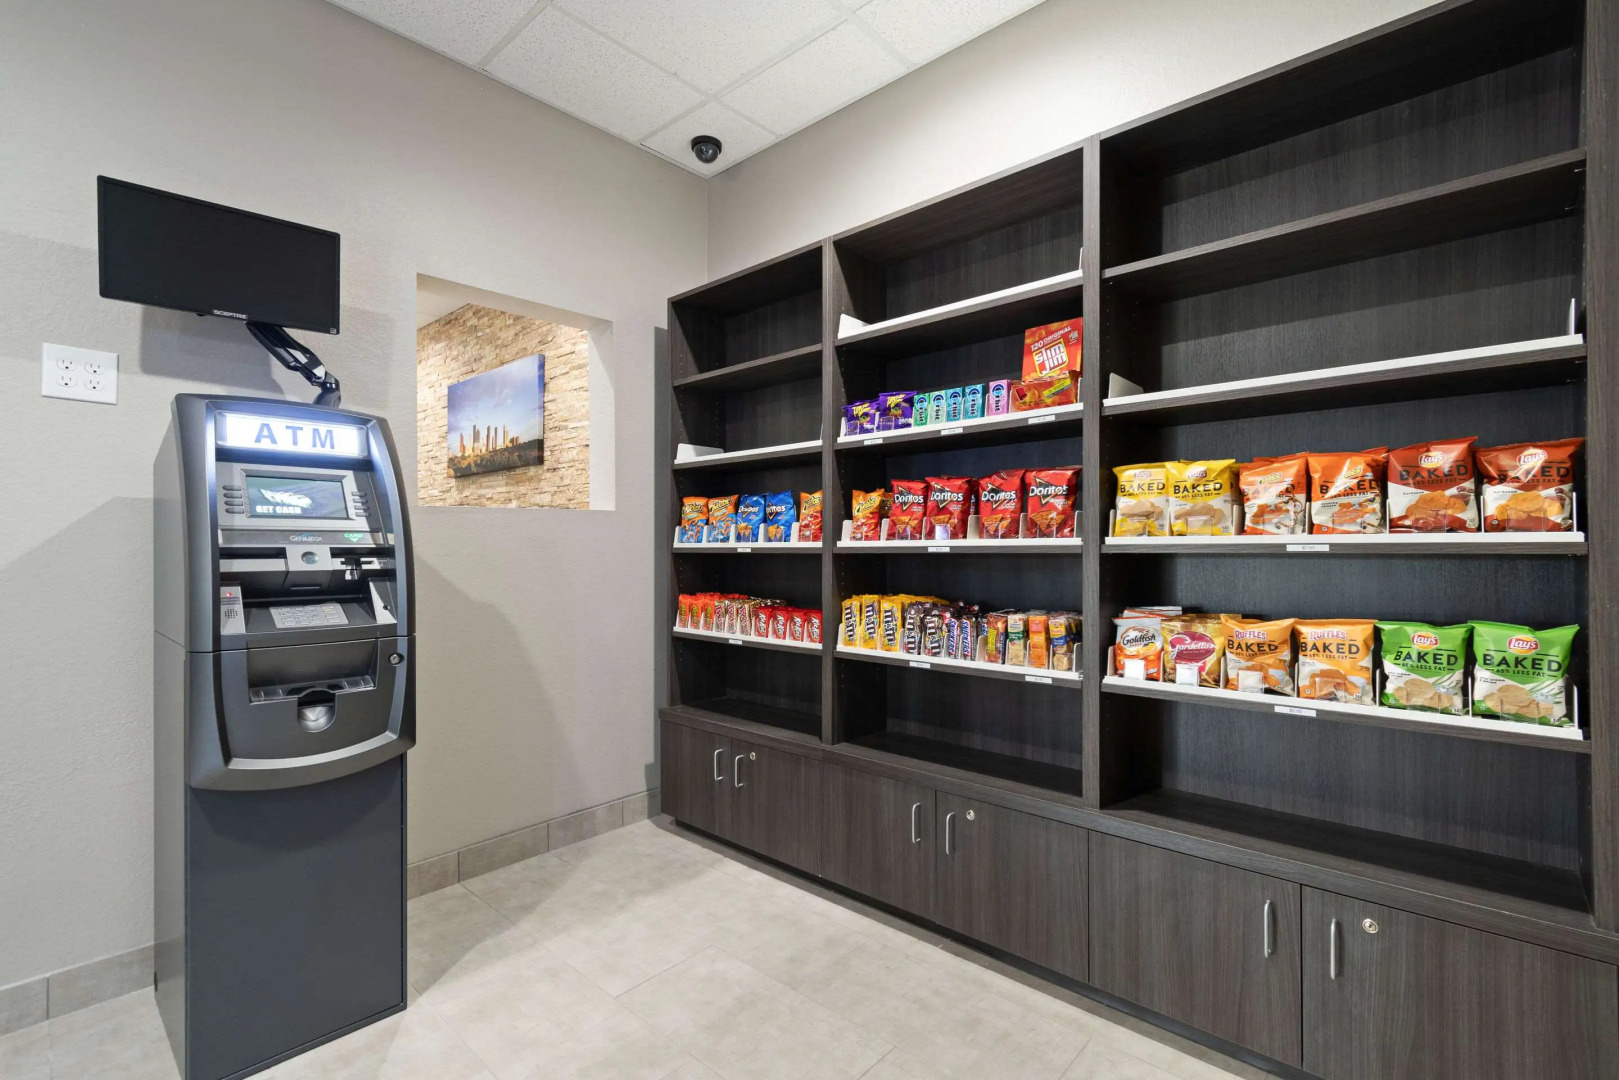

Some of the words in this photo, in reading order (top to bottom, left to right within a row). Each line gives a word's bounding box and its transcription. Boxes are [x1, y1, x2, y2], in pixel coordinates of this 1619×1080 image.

[213, 309, 248, 320] SCEPTRE
[1031, 341, 1044, 352] 120
[1043, 326, 1071, 344] ORIGINAL
[968, 388, 981, 416] Orbit
[992, 384, 1005, 412] Orbit
[254, 423, 336, 450] ATM
[1399, 464, 1469, 481] BAKED
[1029, 485, 1069, 497] Doritos
[1120, 482, 1166, 494] BAKED
[1174, 482, 1223, 495] BAKED
[894, 494, 924, 504] Doritos
[930, 491, 964, 501] Doritos
[981, 490, 1017, 501] Doritos
[255, 505, 274, 513] GET
[275, 506, 302, 514] CASH
[853, 496, 878, 516] Cheetos
[948, 618, 958, 653] SNICKERS
[961, 619, 971, 655] SNICKERS
[1122, 633, 1156, 646] Goldfish
[1234, 630, 1267, 640] RUFFLES
[1310, 630, 1347, 640] RUFFLES
[1227, 639, 1279, 653] BAKED
[1300, 641, 1361, 656] BAKED
[1510, 638, 1538, 650] Lay's
[1394, 651, 1459, 666] BAKED
[1483, 653, 1563, 673] BAKED
